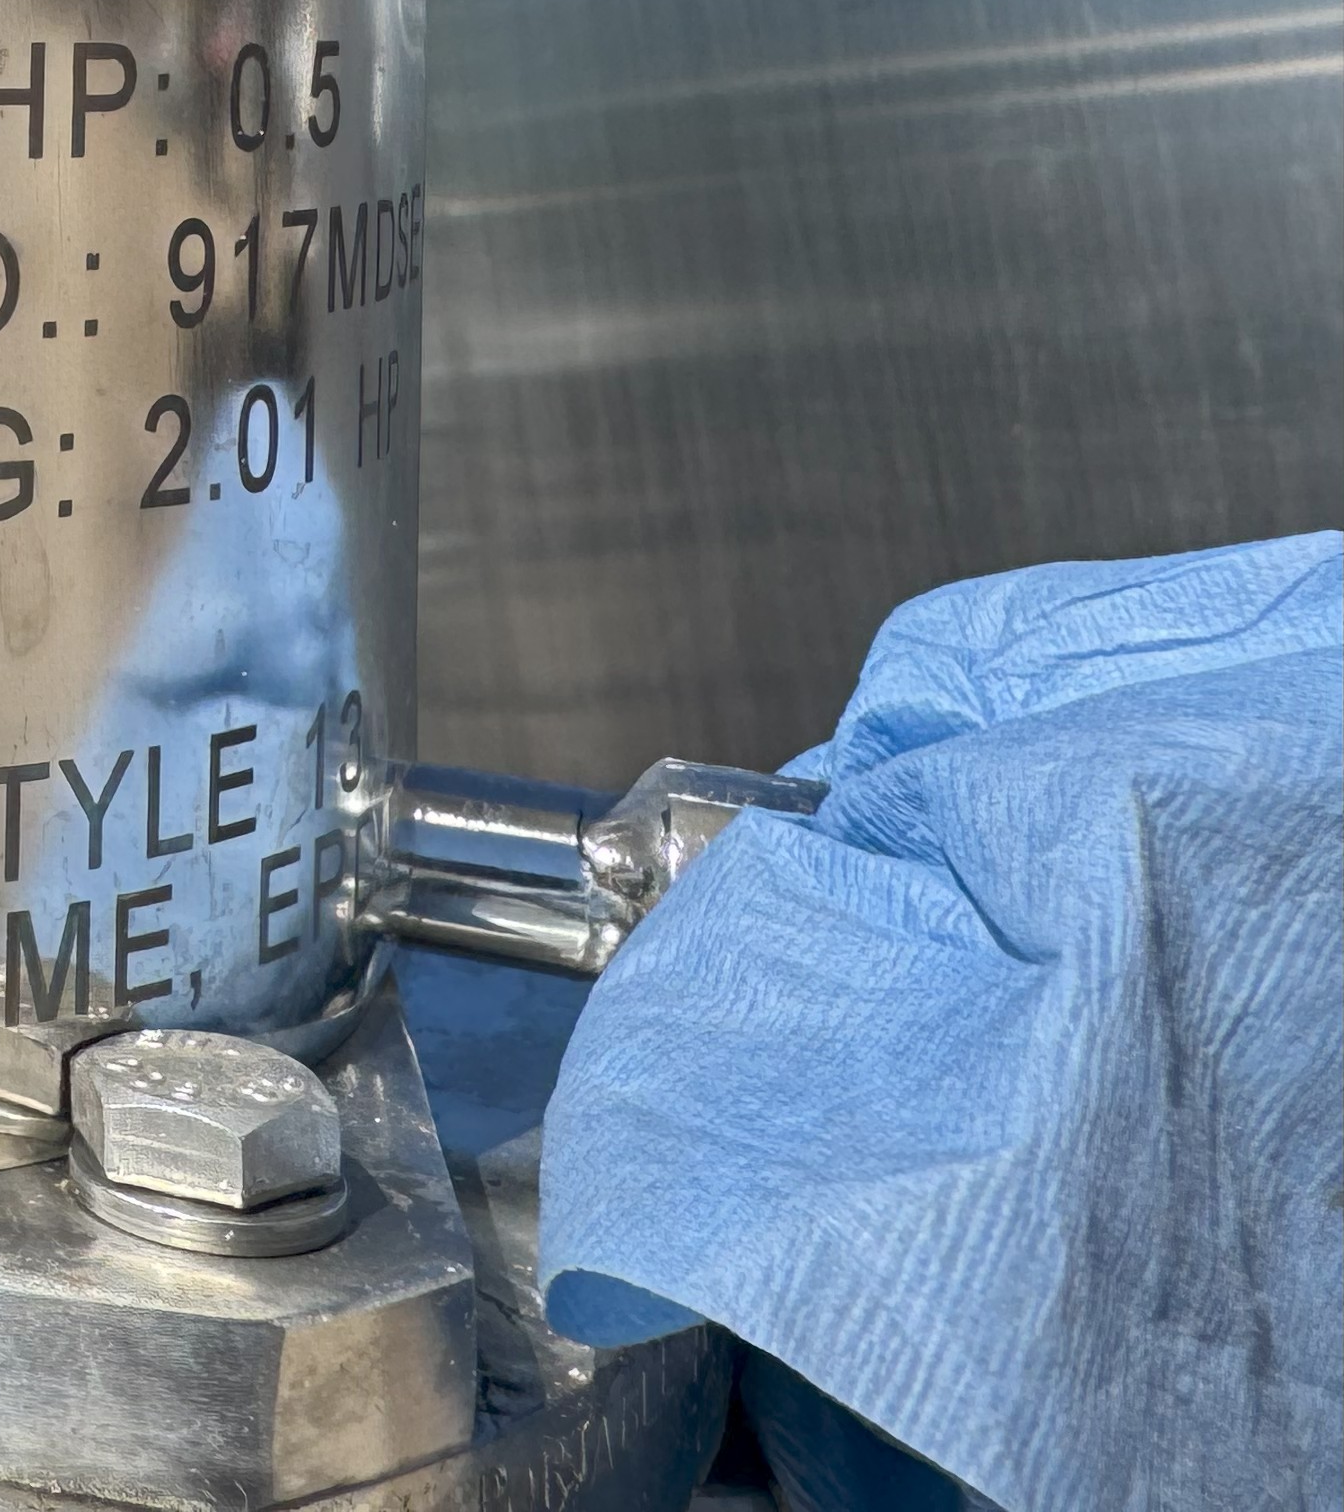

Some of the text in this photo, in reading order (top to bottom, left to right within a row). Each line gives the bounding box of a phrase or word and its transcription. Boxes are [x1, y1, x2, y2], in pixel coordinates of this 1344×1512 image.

[229, 39, 342, 152] 0.5
[140, 375, 315, 509] 2.01
[358, 350, 399, 468] HP
